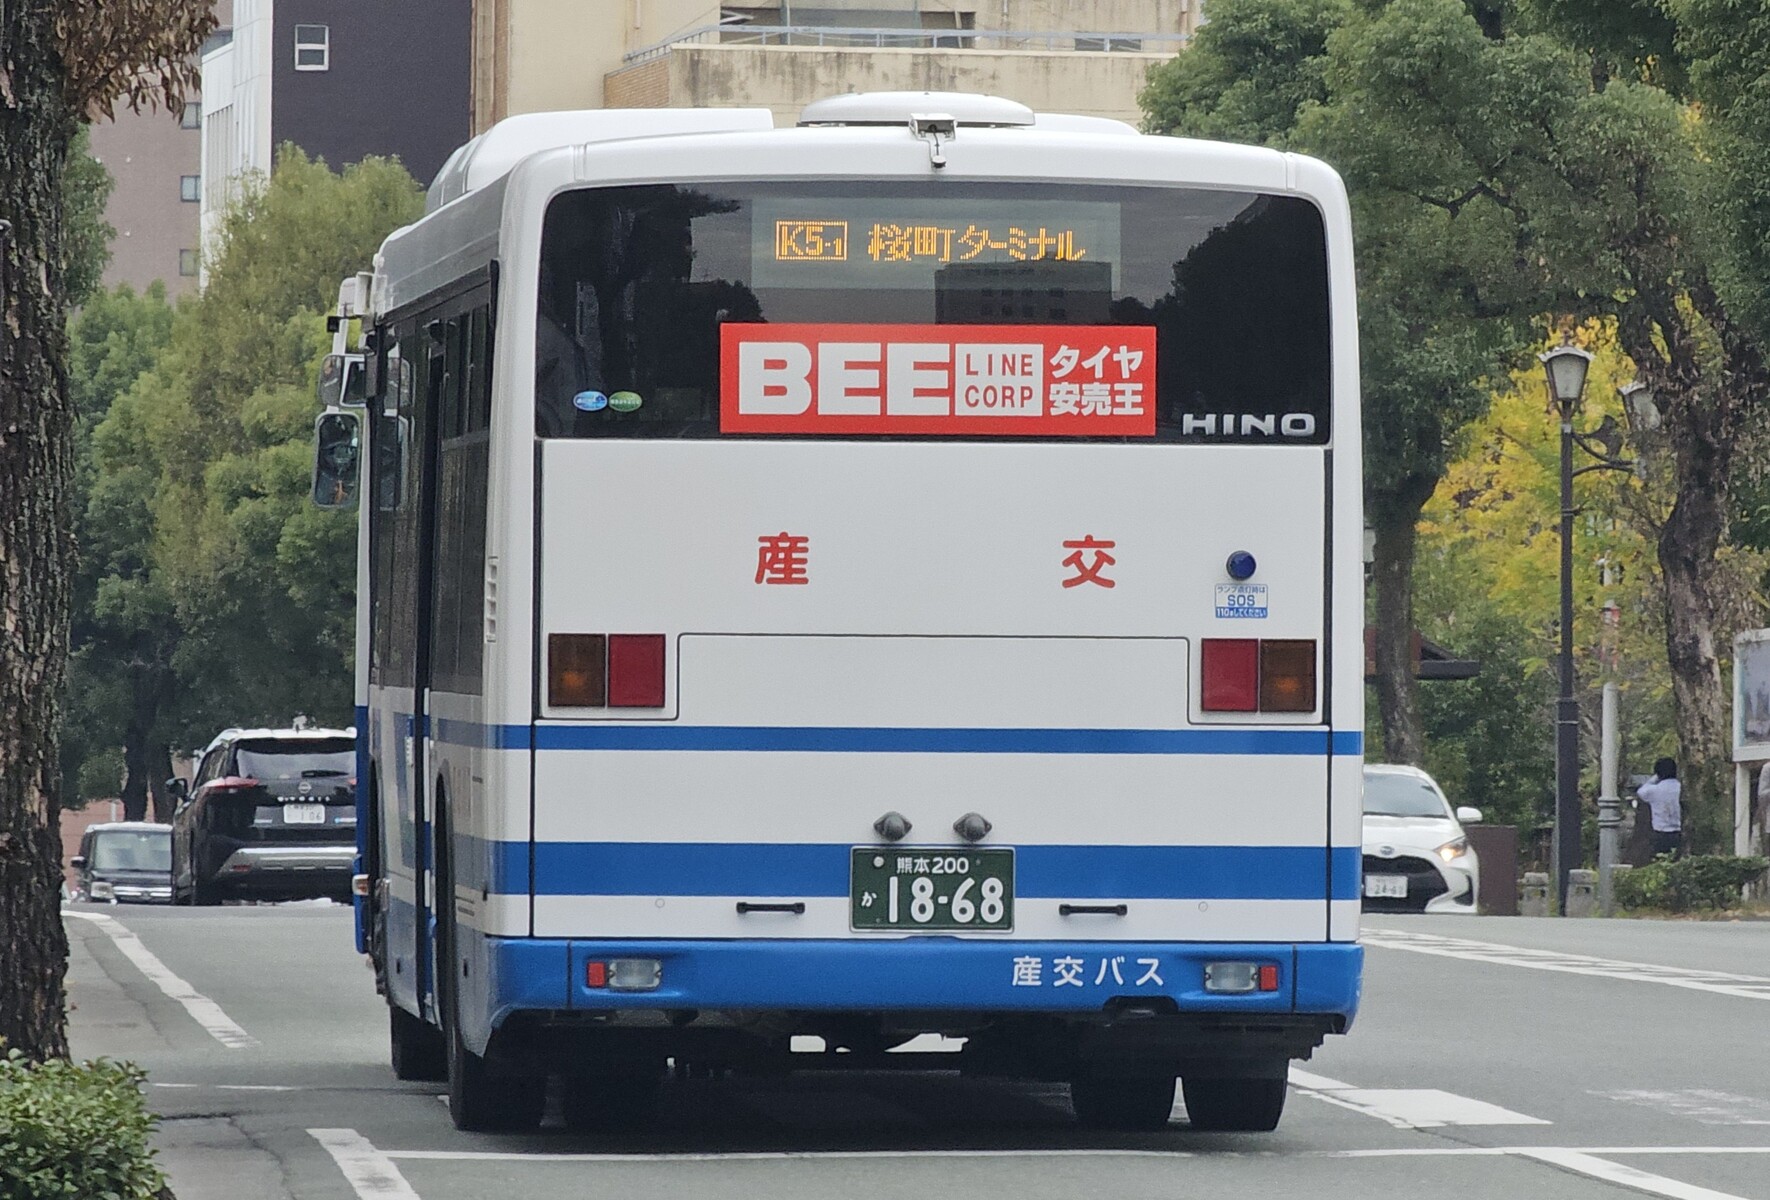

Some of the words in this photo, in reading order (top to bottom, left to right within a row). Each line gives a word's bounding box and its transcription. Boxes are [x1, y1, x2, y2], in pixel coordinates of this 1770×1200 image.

[781, 225, 842, 256] K5-1
[868, 223, 1086, 262] 桜町ターミナル
[965, 353, 1034, 377] LINE
[1049, 345, 1144, 378] タイヤ
[739, 341, 950, 416] BEE
[965, 385, 1033, 409] CORP
[1049, 381, 1144, 416] 安売王
[1183, 413, 1315, 436] HINO
[1227, 594, 1255, 607] SOS
[861, 891, 877, 907] か
[888, 876, 1004, 923] 18-68
[1011, 955, 1164, 988] 産交バス
